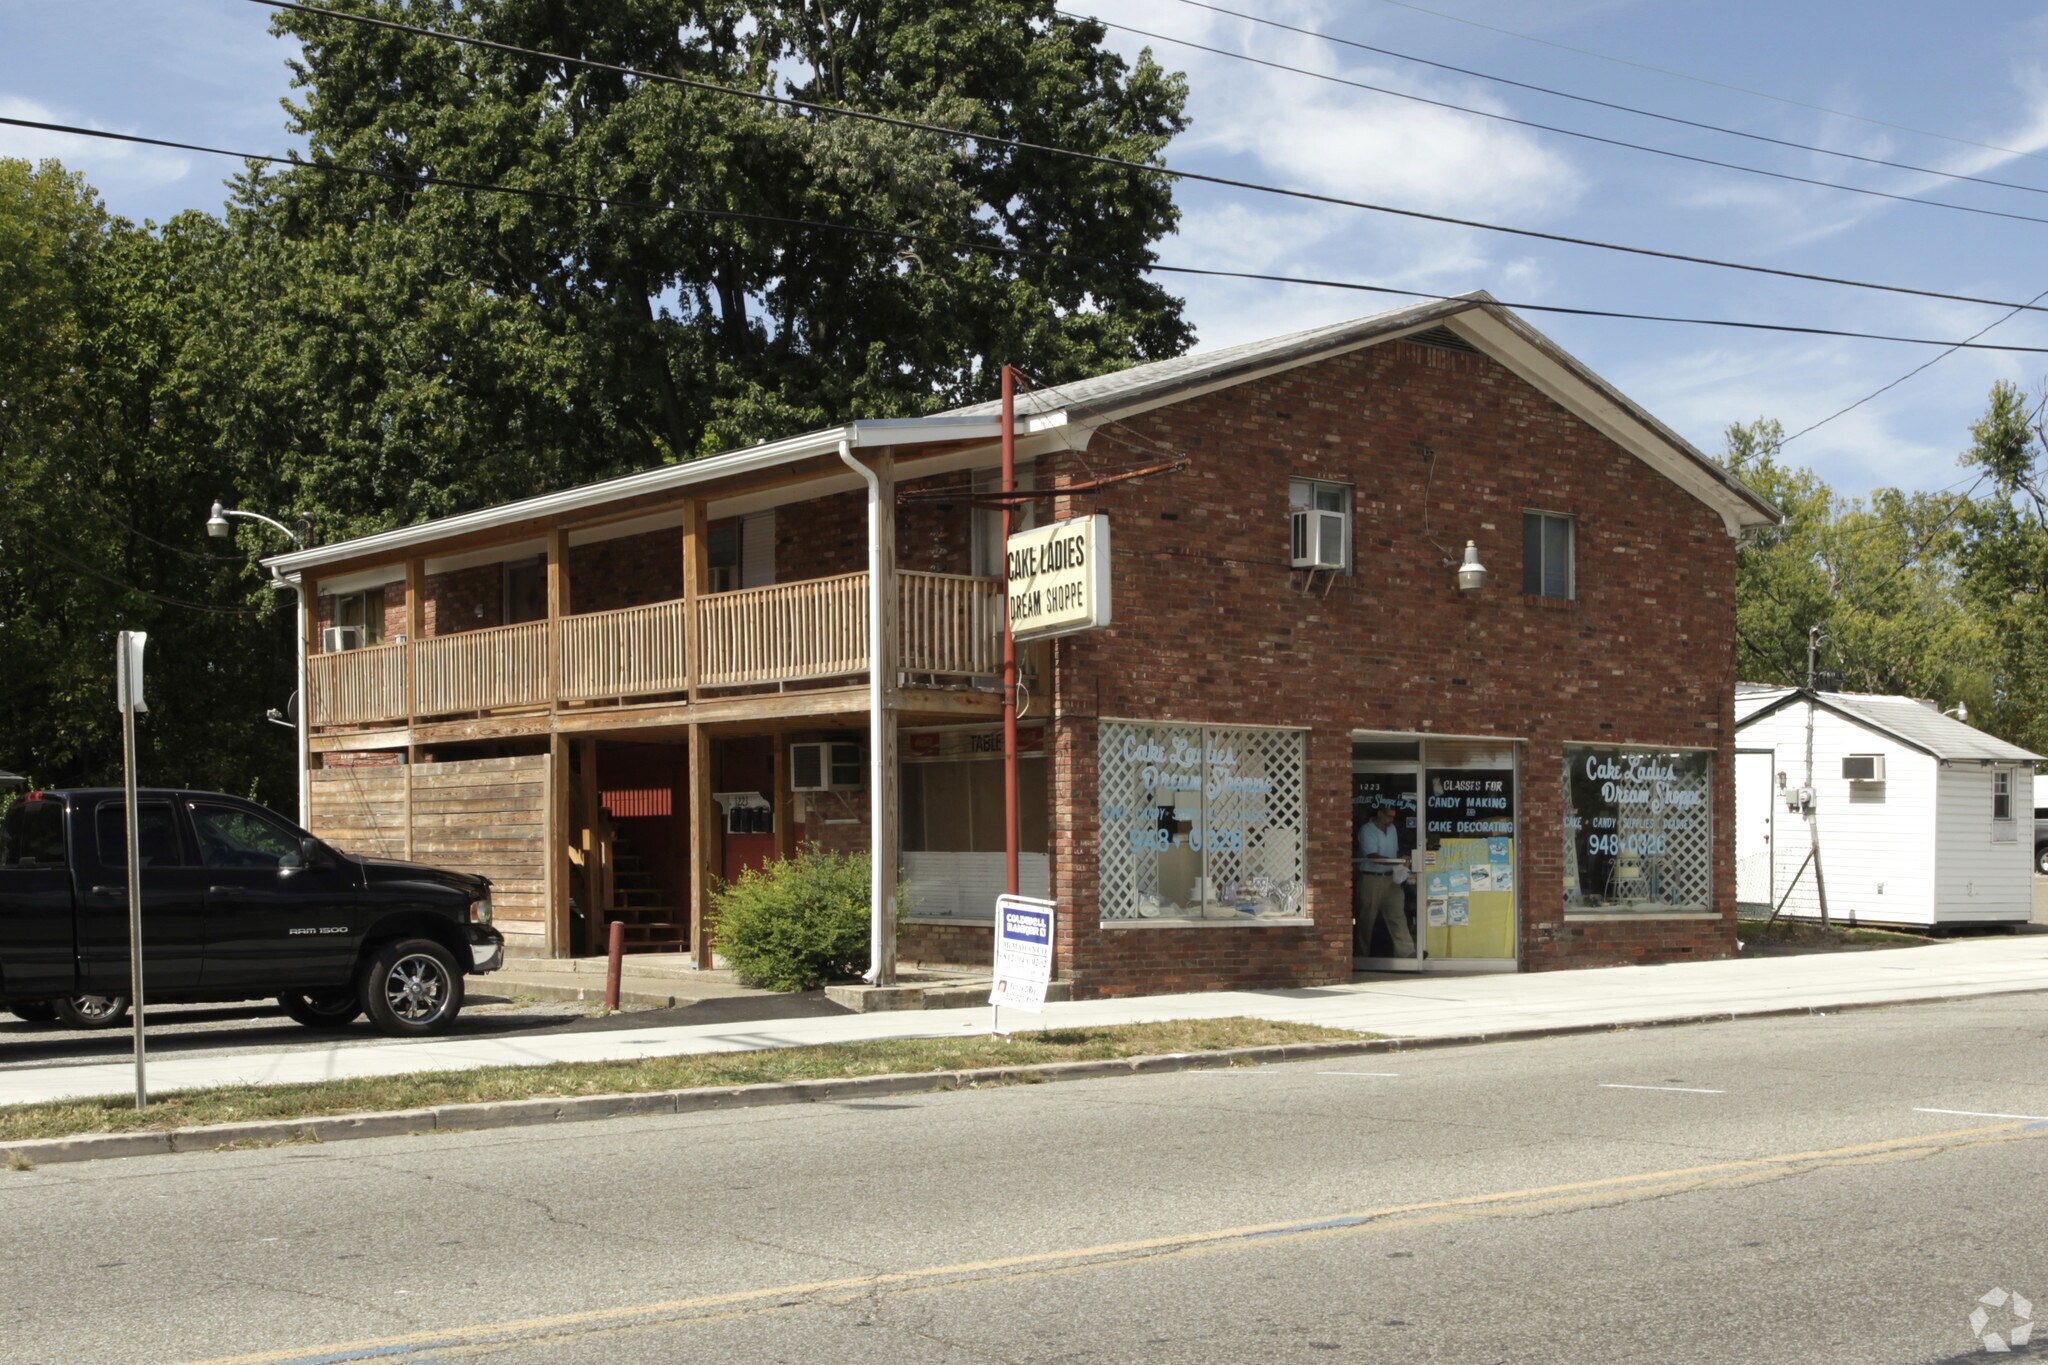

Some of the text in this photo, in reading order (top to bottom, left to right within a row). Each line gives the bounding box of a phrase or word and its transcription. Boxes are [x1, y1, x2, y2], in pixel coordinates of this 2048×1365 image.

[1007, 535, 1084, 581] CAKE LADIES
[1010, 581, 1083, 620] DREAM SHOPPE
[1123, 735, 1167, 764] Cake
[1586, 754, 1677, 783] Cake Ladies
[1142, 766, 1273, 800] Dream Shoppe
[1360, 783, 1380, 791] 1223
[1443, 780, 1503, 792] CLASSES FOR
[1427, 795, 1507, 809] CANDY MAKING
[1601, 780, 1702, 814] Dream Shoppe
[1428, 821, 1513, 833] CAKE DECORATING
[1564, 816, 1582, 828] CAKE
[1592, 817, 1617, 829] CANDY
[1006, 913, 1047, 928] COLDWELL
[319, 926, 348, 934] 1500
[1006, 922, 1039, 936] BANKER
